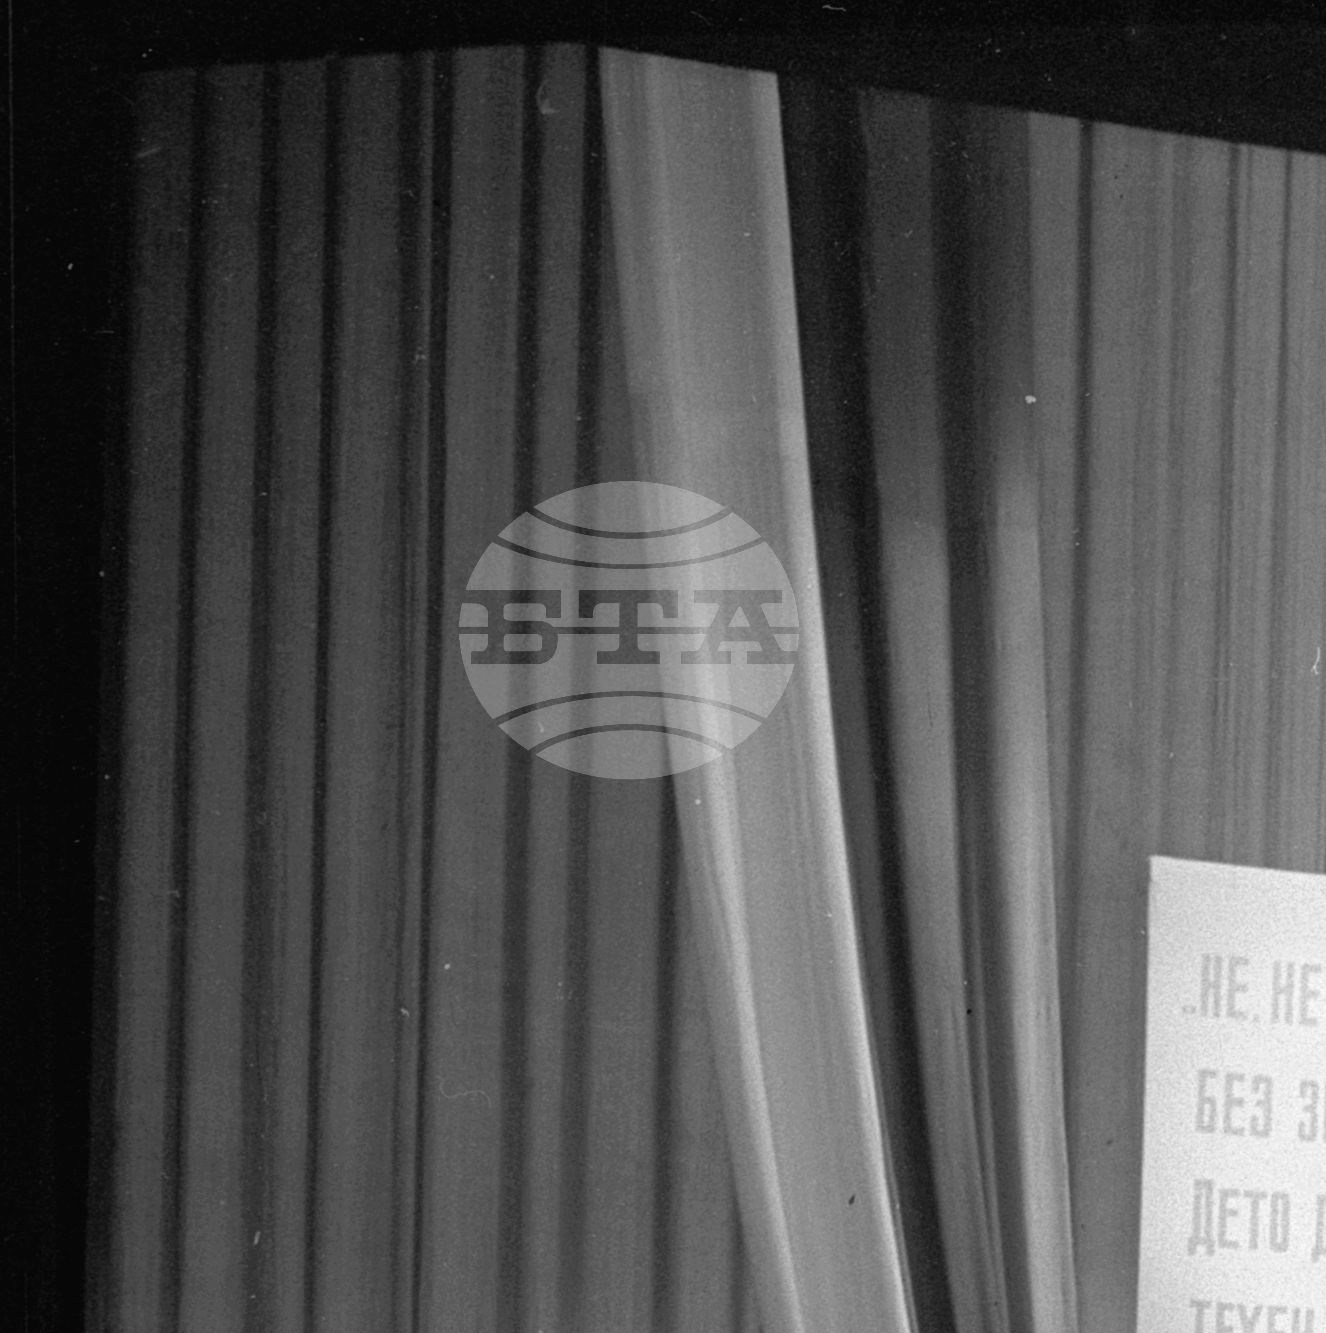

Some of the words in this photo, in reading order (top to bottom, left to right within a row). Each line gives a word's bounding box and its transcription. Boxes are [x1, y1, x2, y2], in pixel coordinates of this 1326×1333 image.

[1271, 960, 1323, 1027] НЕ
[1195, 1067, 1274, 1138] БЕЗ
[1186, 1178, 1291, 1256] ДЕТО
